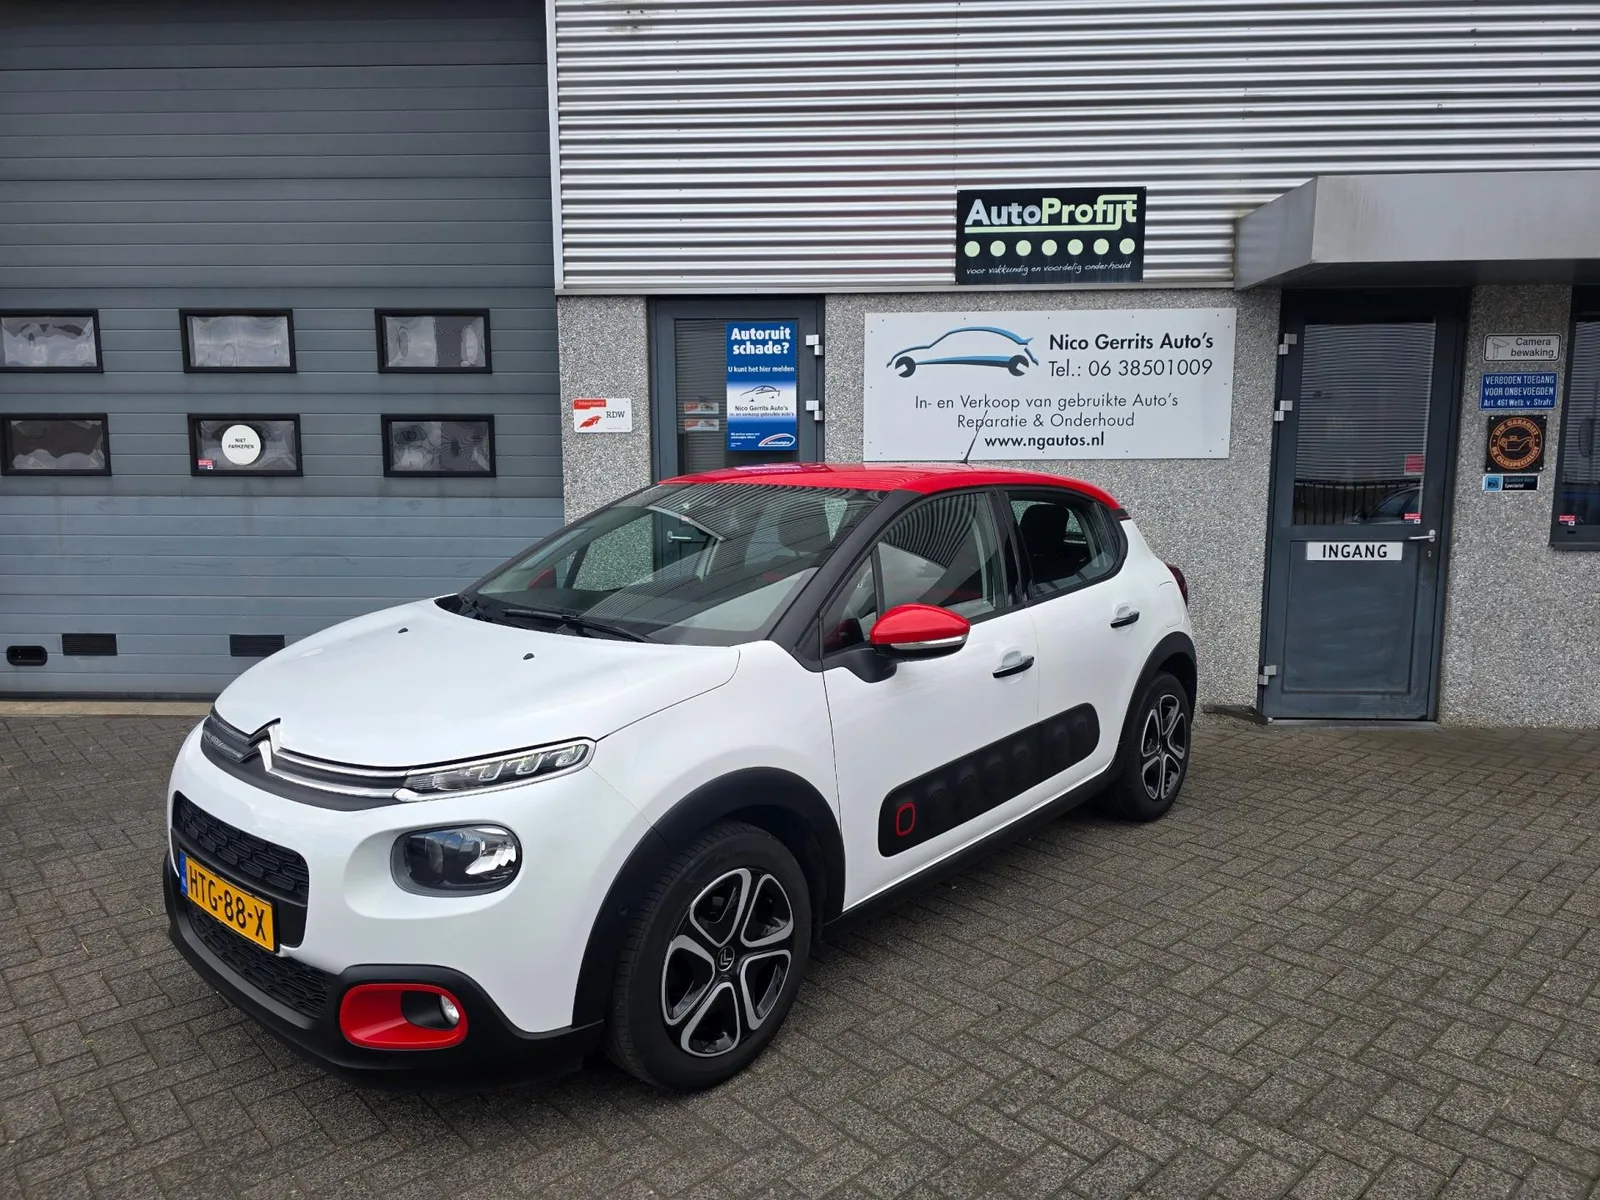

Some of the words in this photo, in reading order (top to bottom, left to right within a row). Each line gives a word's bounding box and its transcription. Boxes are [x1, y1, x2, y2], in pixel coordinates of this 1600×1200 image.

[965, 194, 1137, 232] AutoProfijt
[966, 267, 985, 275] voor
[989, 265, 1028, 276] vakkundig
[1044, 262, 1081, 274] voordelig
[1085, 261, 1131, 271] onderhoud
[731, 326, 791, 340] Autoruit
[733, 341, 790, 354] schade?
[1049, 334, 1089, 350] Nico
[1095, 333, 1154, 350] Gerrits
[1160, 332, 1213, 349] Auto's
[1516, 337, 1551, 346] Camera
[1511, 348, 1554, 359] bewaking
[1048, 359, 1082, 376] Tel.:
[1088, 359, 1111, 376] 06
[1118, 358, 1213, 376] 38501009
[1485, 376, 1522, 384] VERBODEN
[1523, 375, 1554, 384] TOEGANG
[1485, 387, 1503, 396] VOOR
[1504, 387, 1553, 396] ONBEVOEGDEN
[915, 396, 932, 409] In-
[937, 398, 954, 408] en
[960, 394, 1020, 411] Verkoop
[1026, 398, 1051, 408] van
[1057, 393, 1126, 411] gebruikte
[1132, 393, 1178, 407] Auto's
[957, 414, 1027, 431] Reparatie
[1033, 414, 1044, 427] &
[1050, 411, 1135, 428] Onderhoud
[985, 431, 1104, 450] www.ngautos.nl
[1322, 544, 1387, 558] INGANG
[189, 865, 267, 941] HTG-88-X
